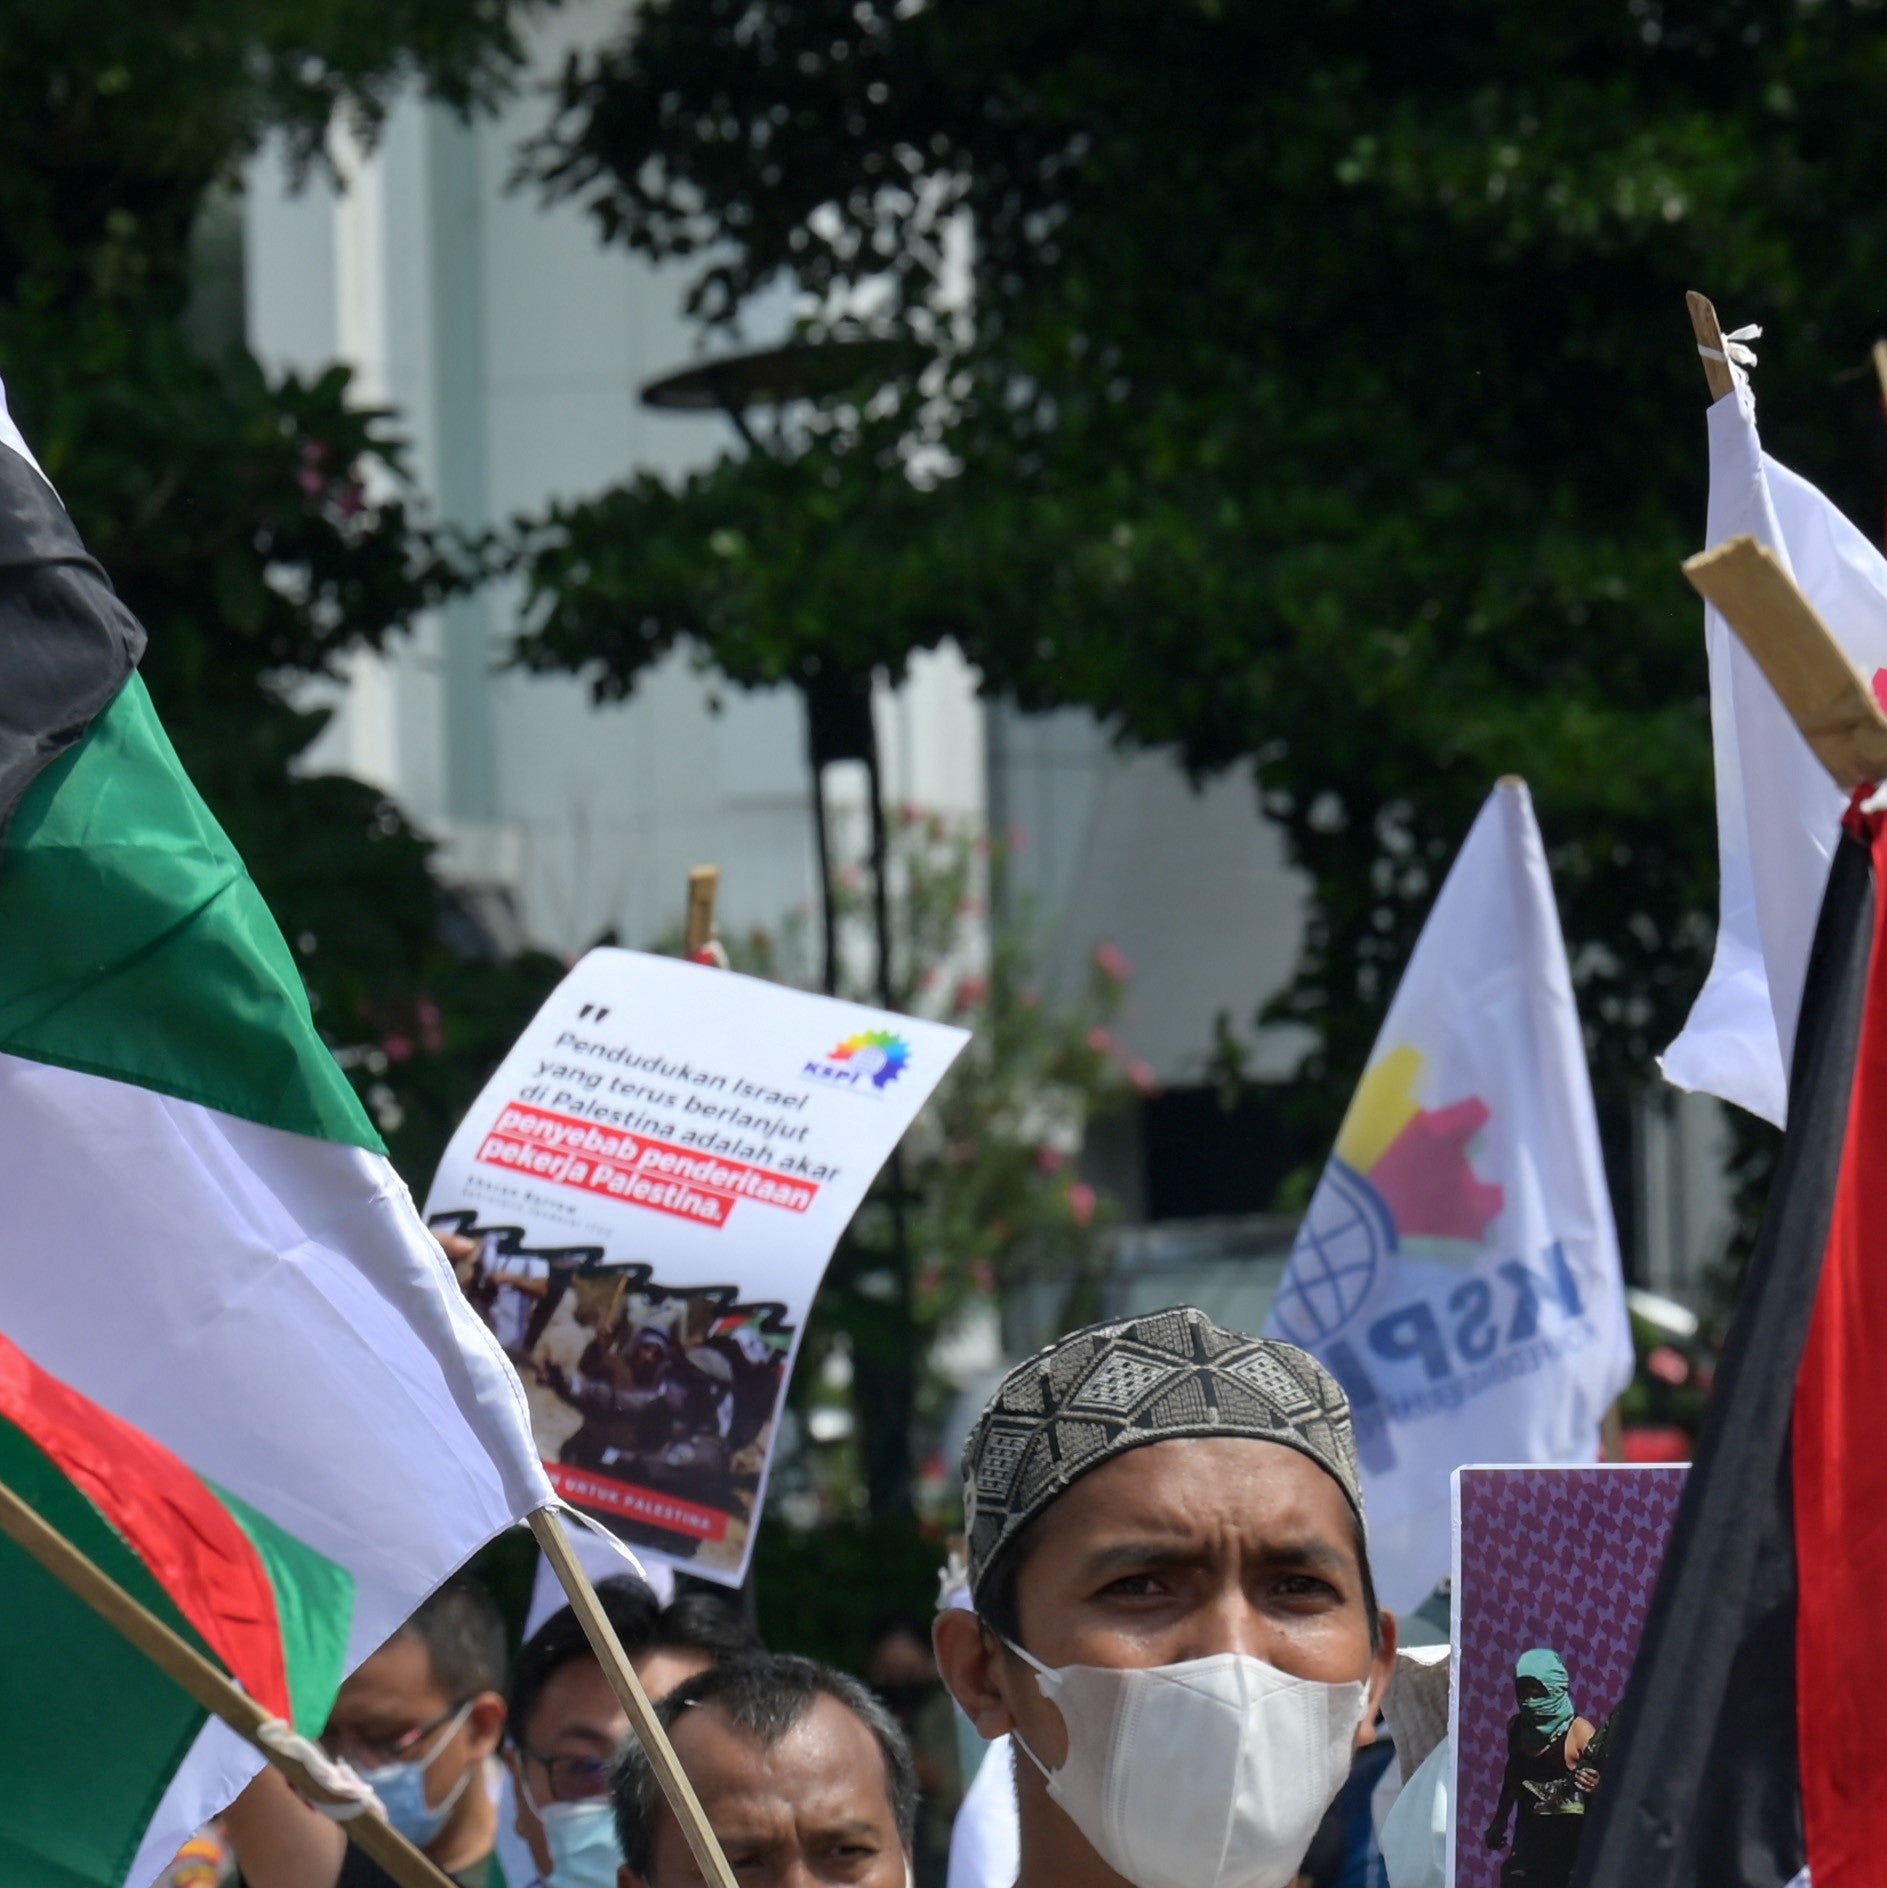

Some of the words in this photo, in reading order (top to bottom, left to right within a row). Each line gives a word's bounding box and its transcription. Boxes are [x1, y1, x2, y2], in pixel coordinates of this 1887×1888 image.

[533, 1060, 603, 1091] yang
[610, 1077, 678, 1107] terus
[684, 1095, 810, 1143] berlanjut
[556, 1032, 728, 1089] Pendudukan
[733, 1078, 809, 1112] Israel
[496, 1110, 639, 1161] penyebab
[637, 1147, 813, 1208] penderitaan
[519, 1084, 548, 1102] di
[552, 1091, 676, 1138] Palestina
[682, 1129, 773, 1164] adalah
[780, 1154, 841, 1182] akar
[480, 1137, 589, 1183] pekerja
[590, 1163, 723, 1221] Palestina.
